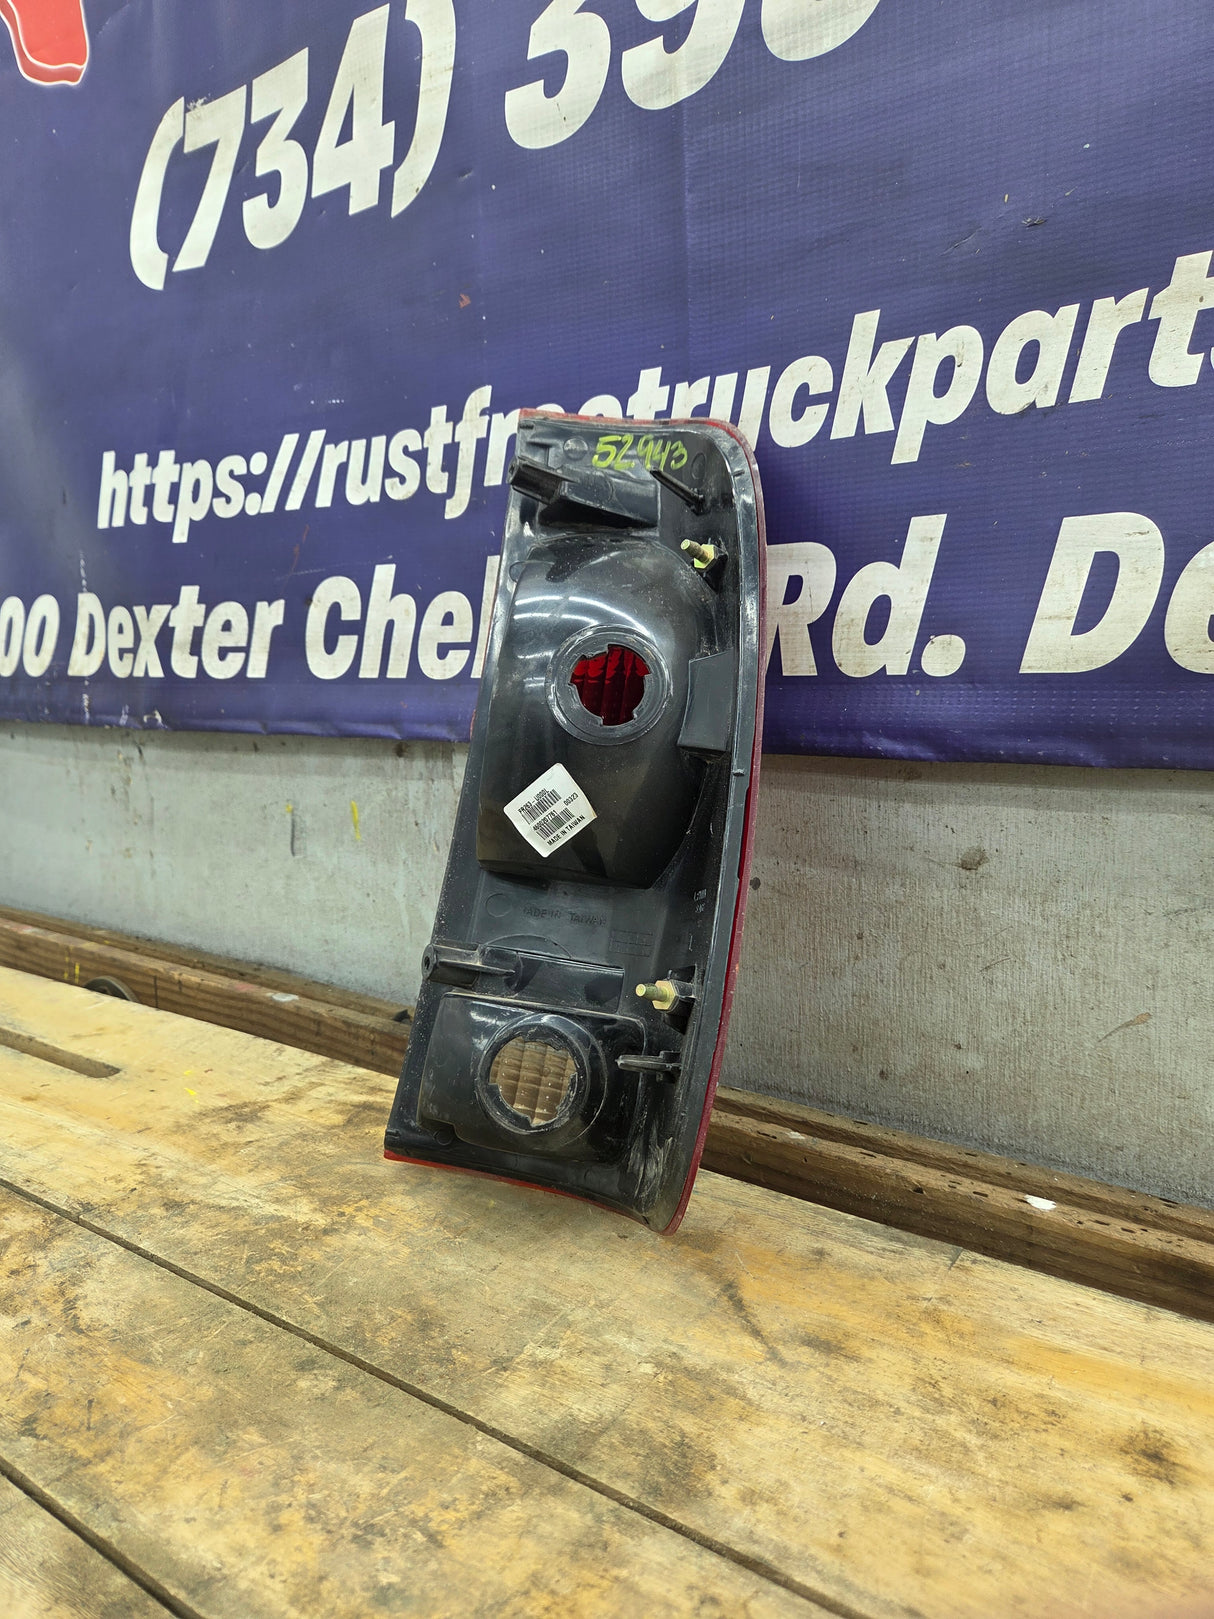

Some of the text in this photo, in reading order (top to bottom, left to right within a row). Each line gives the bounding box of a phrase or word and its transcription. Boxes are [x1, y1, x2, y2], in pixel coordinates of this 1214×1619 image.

[129, 0, 882, 291] (734) 39
[67, 585, 285, 679] Dexter
[304, 555, 500, 680] Chel
[765, 513, 967, 678] Rd.
[547, 833, 561, 846] MADE
[565, 815, 586, 832] TAIWAN
